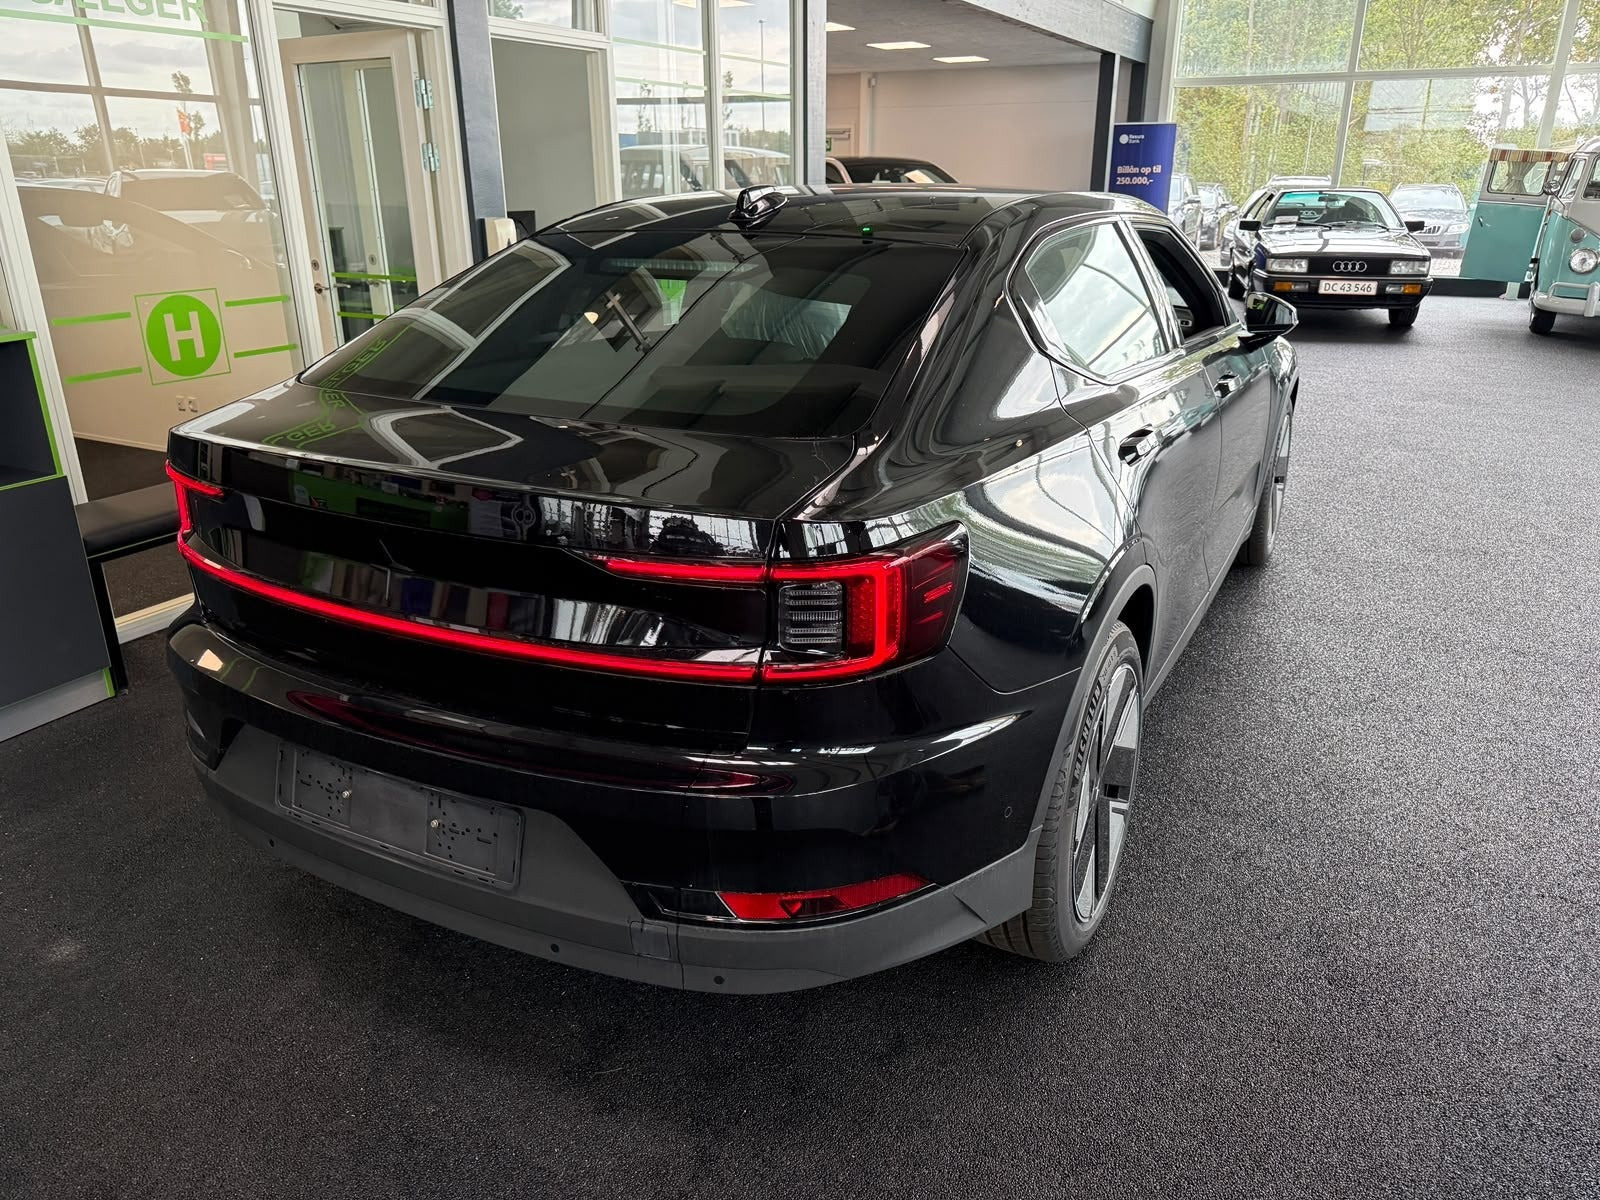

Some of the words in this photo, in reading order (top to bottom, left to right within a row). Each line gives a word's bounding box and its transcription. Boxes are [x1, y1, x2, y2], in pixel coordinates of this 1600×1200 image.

[1117, 165, 1139, 174] Billån
[1140, 167, 1151, 175] op
[1152, 165, 1162, 173] til
[1116, 177, 1154, 185] 250.000,-
[1323, 282, 1338, 292] DC
[1340, 282, 1352, 292] 43
[1354, 283, 1372, 293] 546
[163, 311, 206, 362] H
[1073, 686, 1102, 779] MICHELIN
